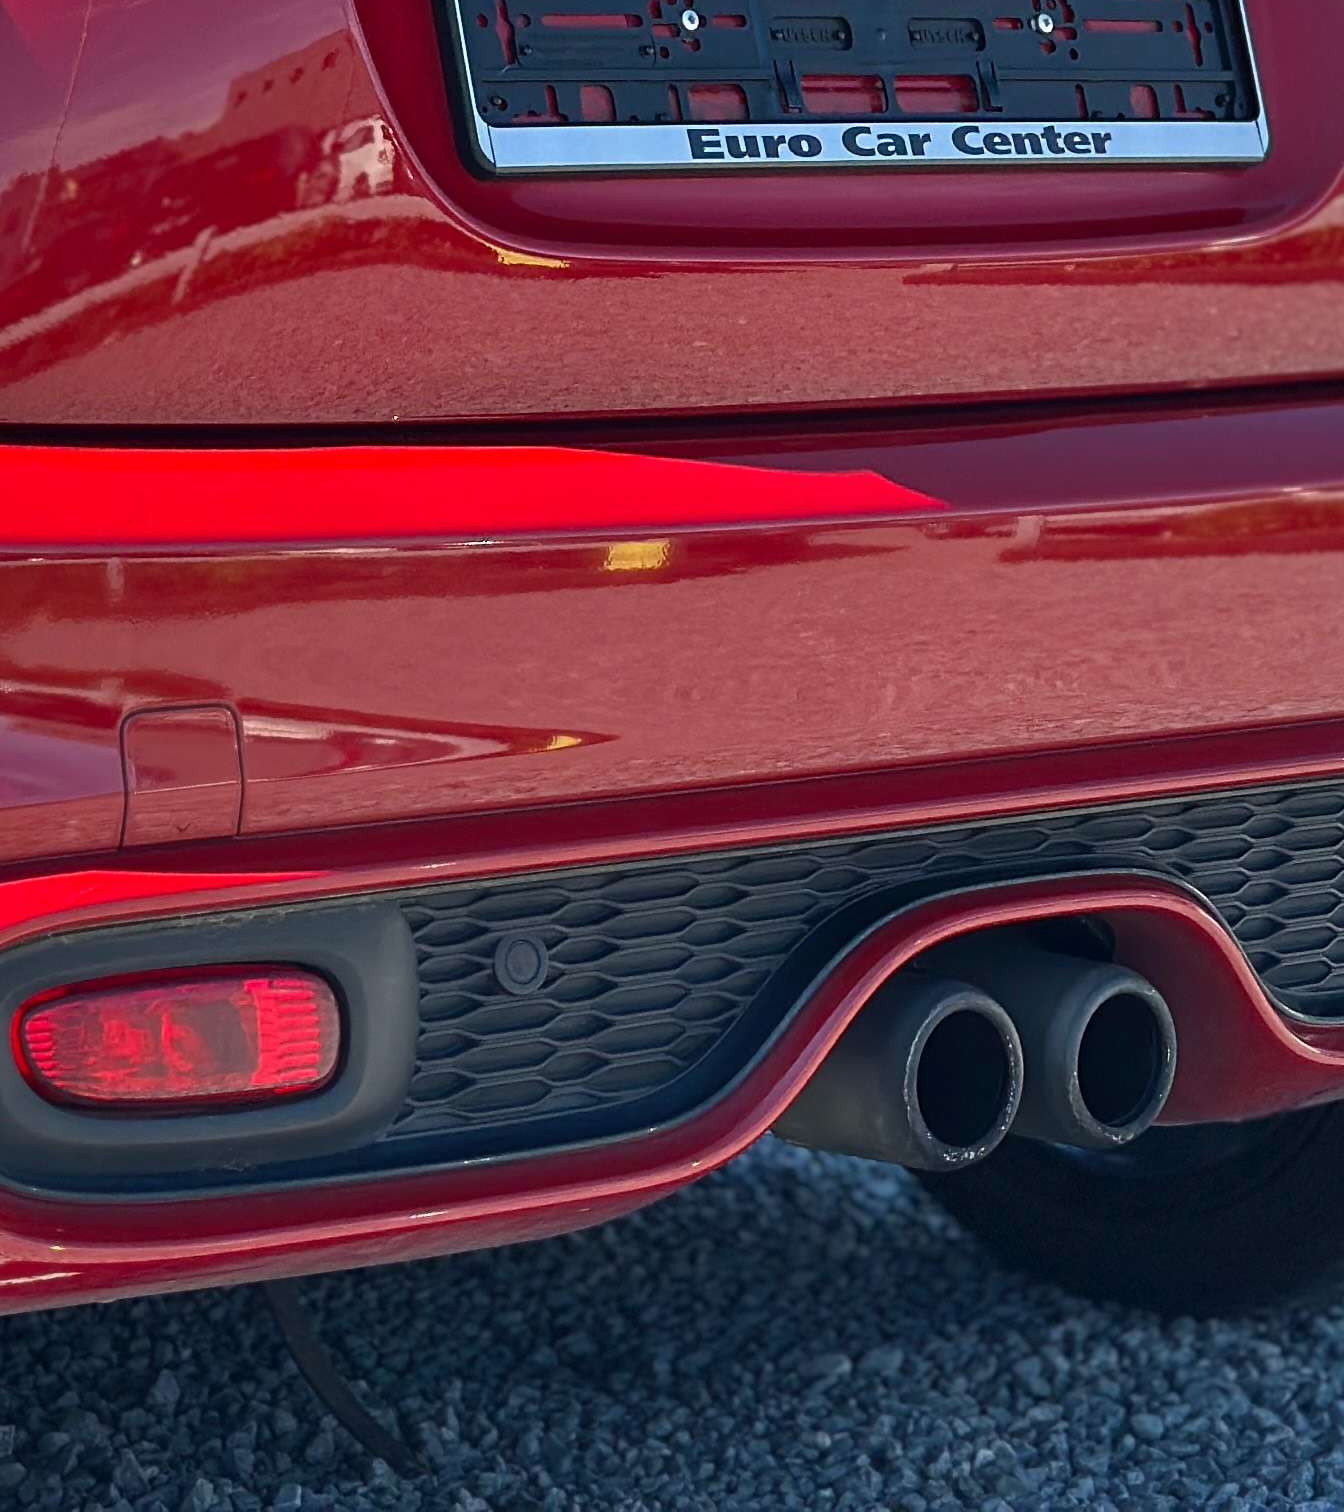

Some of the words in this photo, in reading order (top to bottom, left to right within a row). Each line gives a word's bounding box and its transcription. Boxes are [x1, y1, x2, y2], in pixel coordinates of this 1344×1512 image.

[686, 127, 823, 160] Euro
[841, 126, 933, 158] Car
[951, 125, 1113, 156] Center
